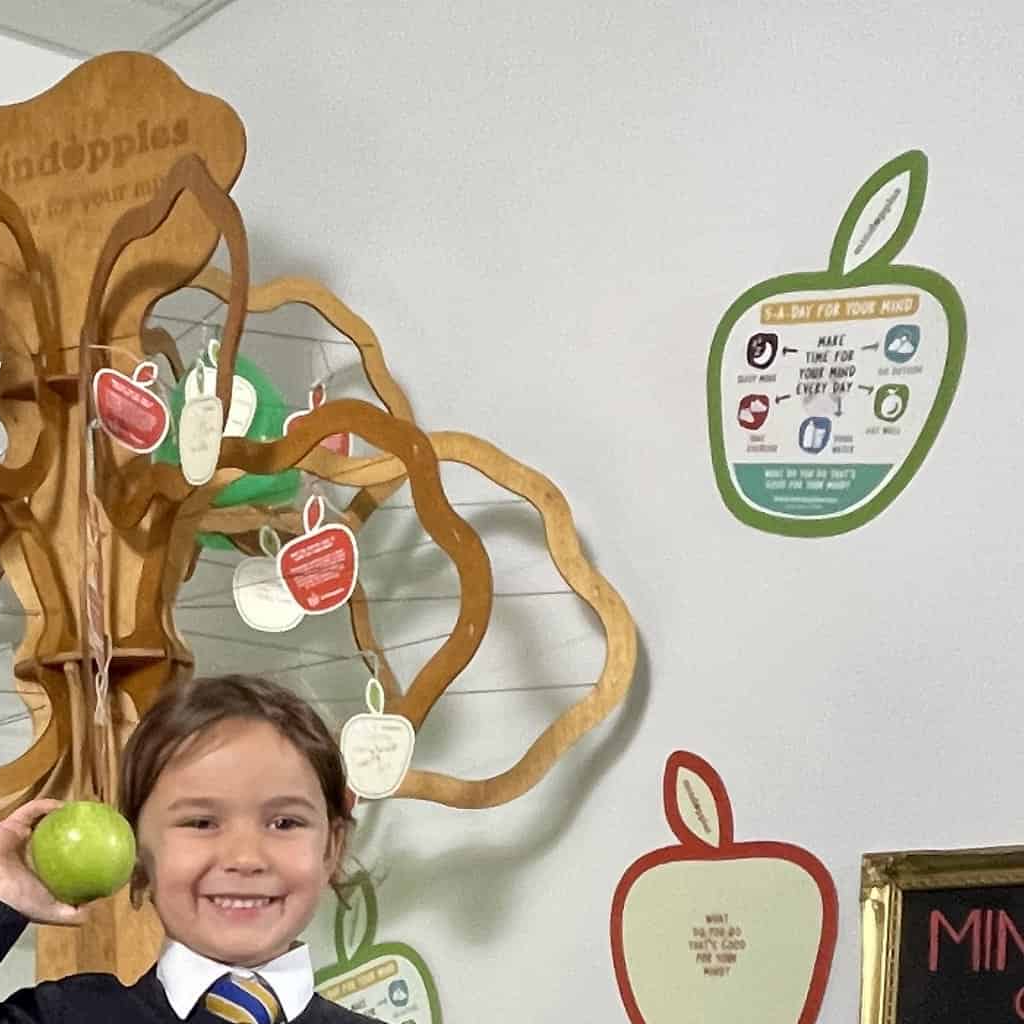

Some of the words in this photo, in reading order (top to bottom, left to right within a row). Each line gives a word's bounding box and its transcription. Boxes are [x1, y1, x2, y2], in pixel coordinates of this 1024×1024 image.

[816, 302, 840, 320] FOR
[846, 300, 876, 317] YOUR
[880, 297, 914, 314] MIND
[817, 334, 846, 347] MAKE
[805, 350, 829, 363] TIME
[834, 350, 855, 363] FOR
[799, 367, 824, 380] YOUR
[828, 365, 857, 379] MIND
[796, 382, 828, 395] EVERY
[832, 381, 854, 394] DAY
[928, 909, 1024, 972] MIN
